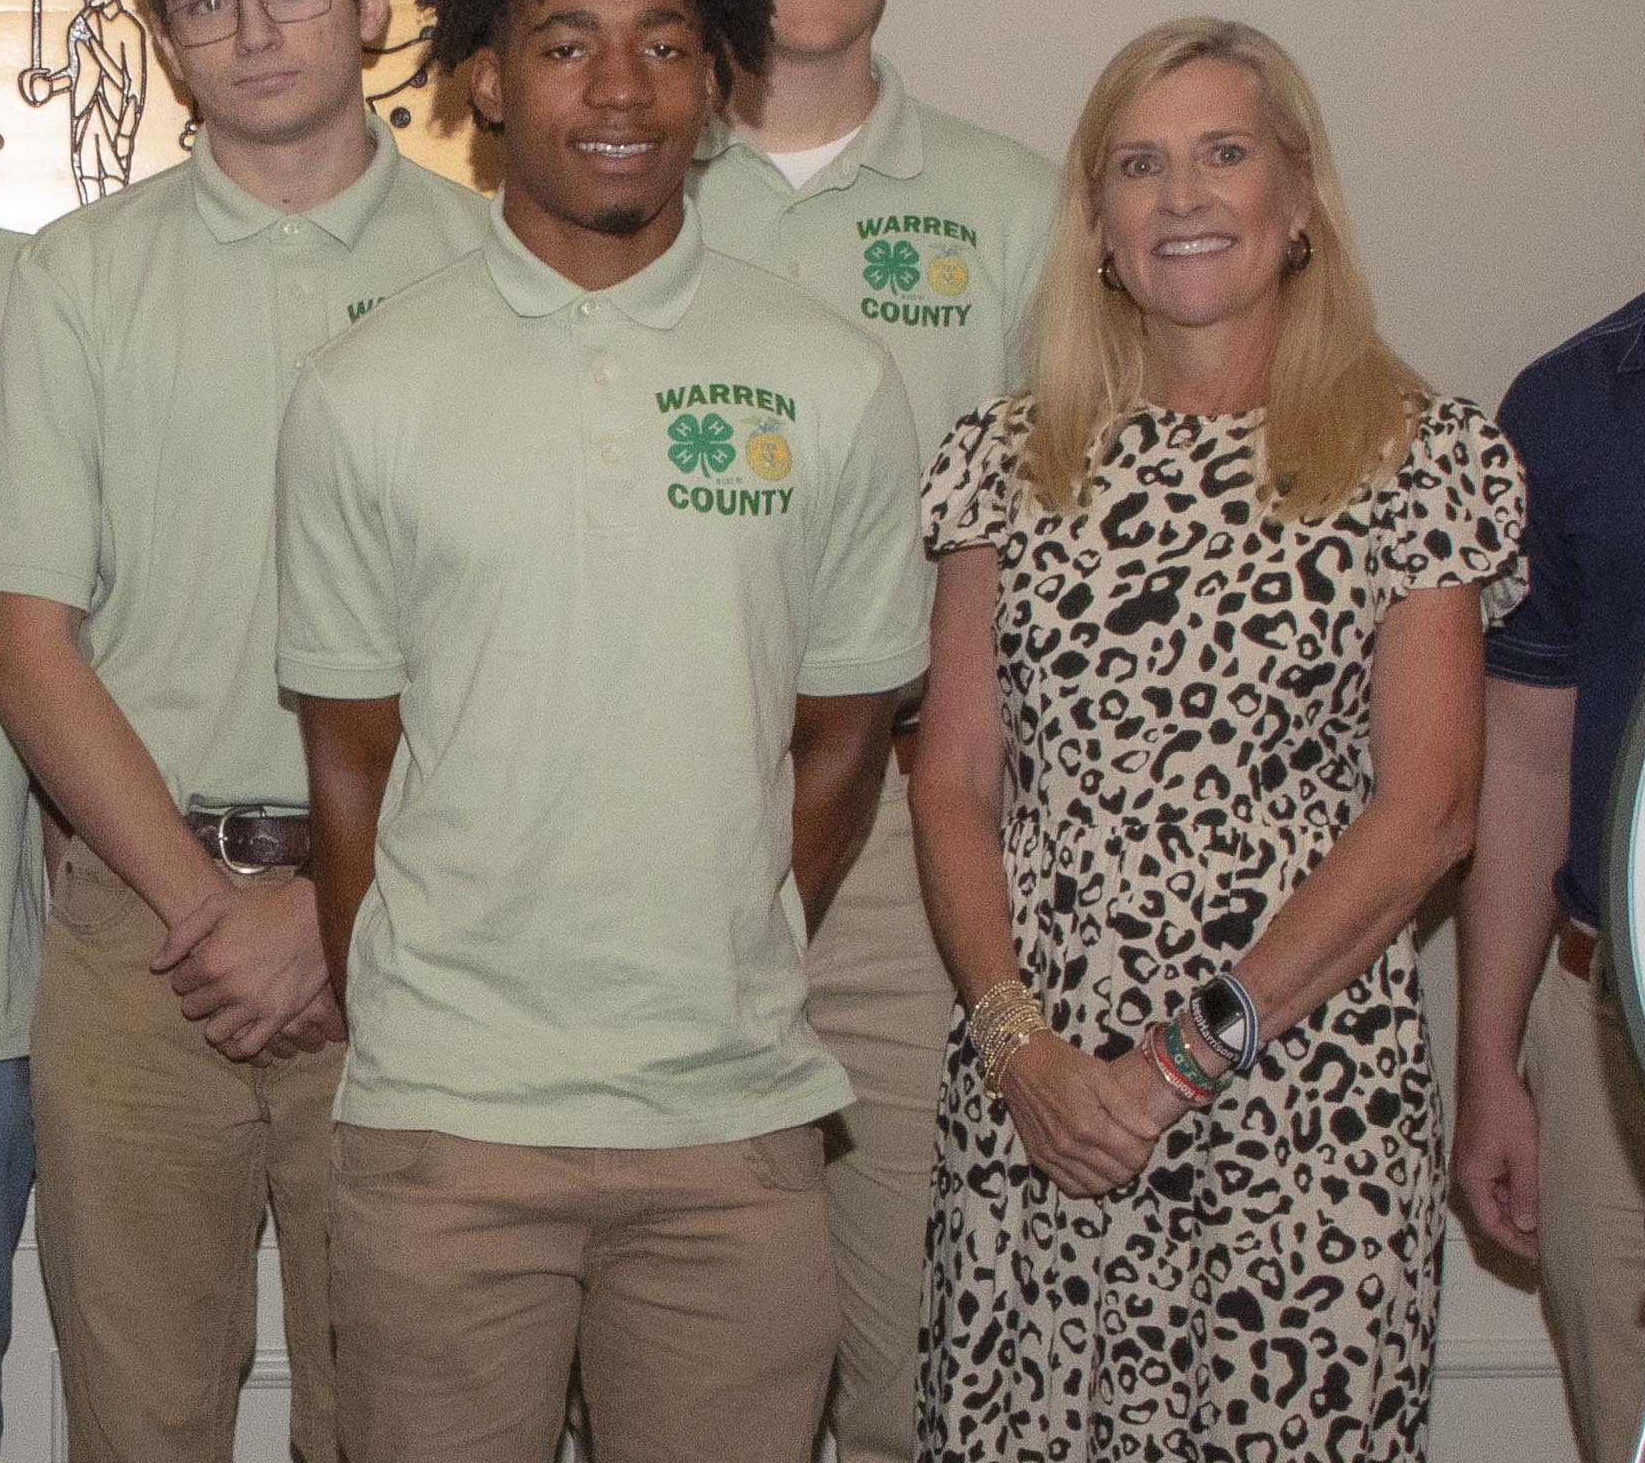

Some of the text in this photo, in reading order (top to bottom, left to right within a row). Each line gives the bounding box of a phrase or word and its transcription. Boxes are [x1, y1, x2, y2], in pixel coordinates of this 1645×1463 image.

[856, 214, 977, 250] WARREN
[861, 297, 972, 327] COUNTY
[655, 383, 797, 423] WARREN
[667, 483, 795, 517] COUNTY
